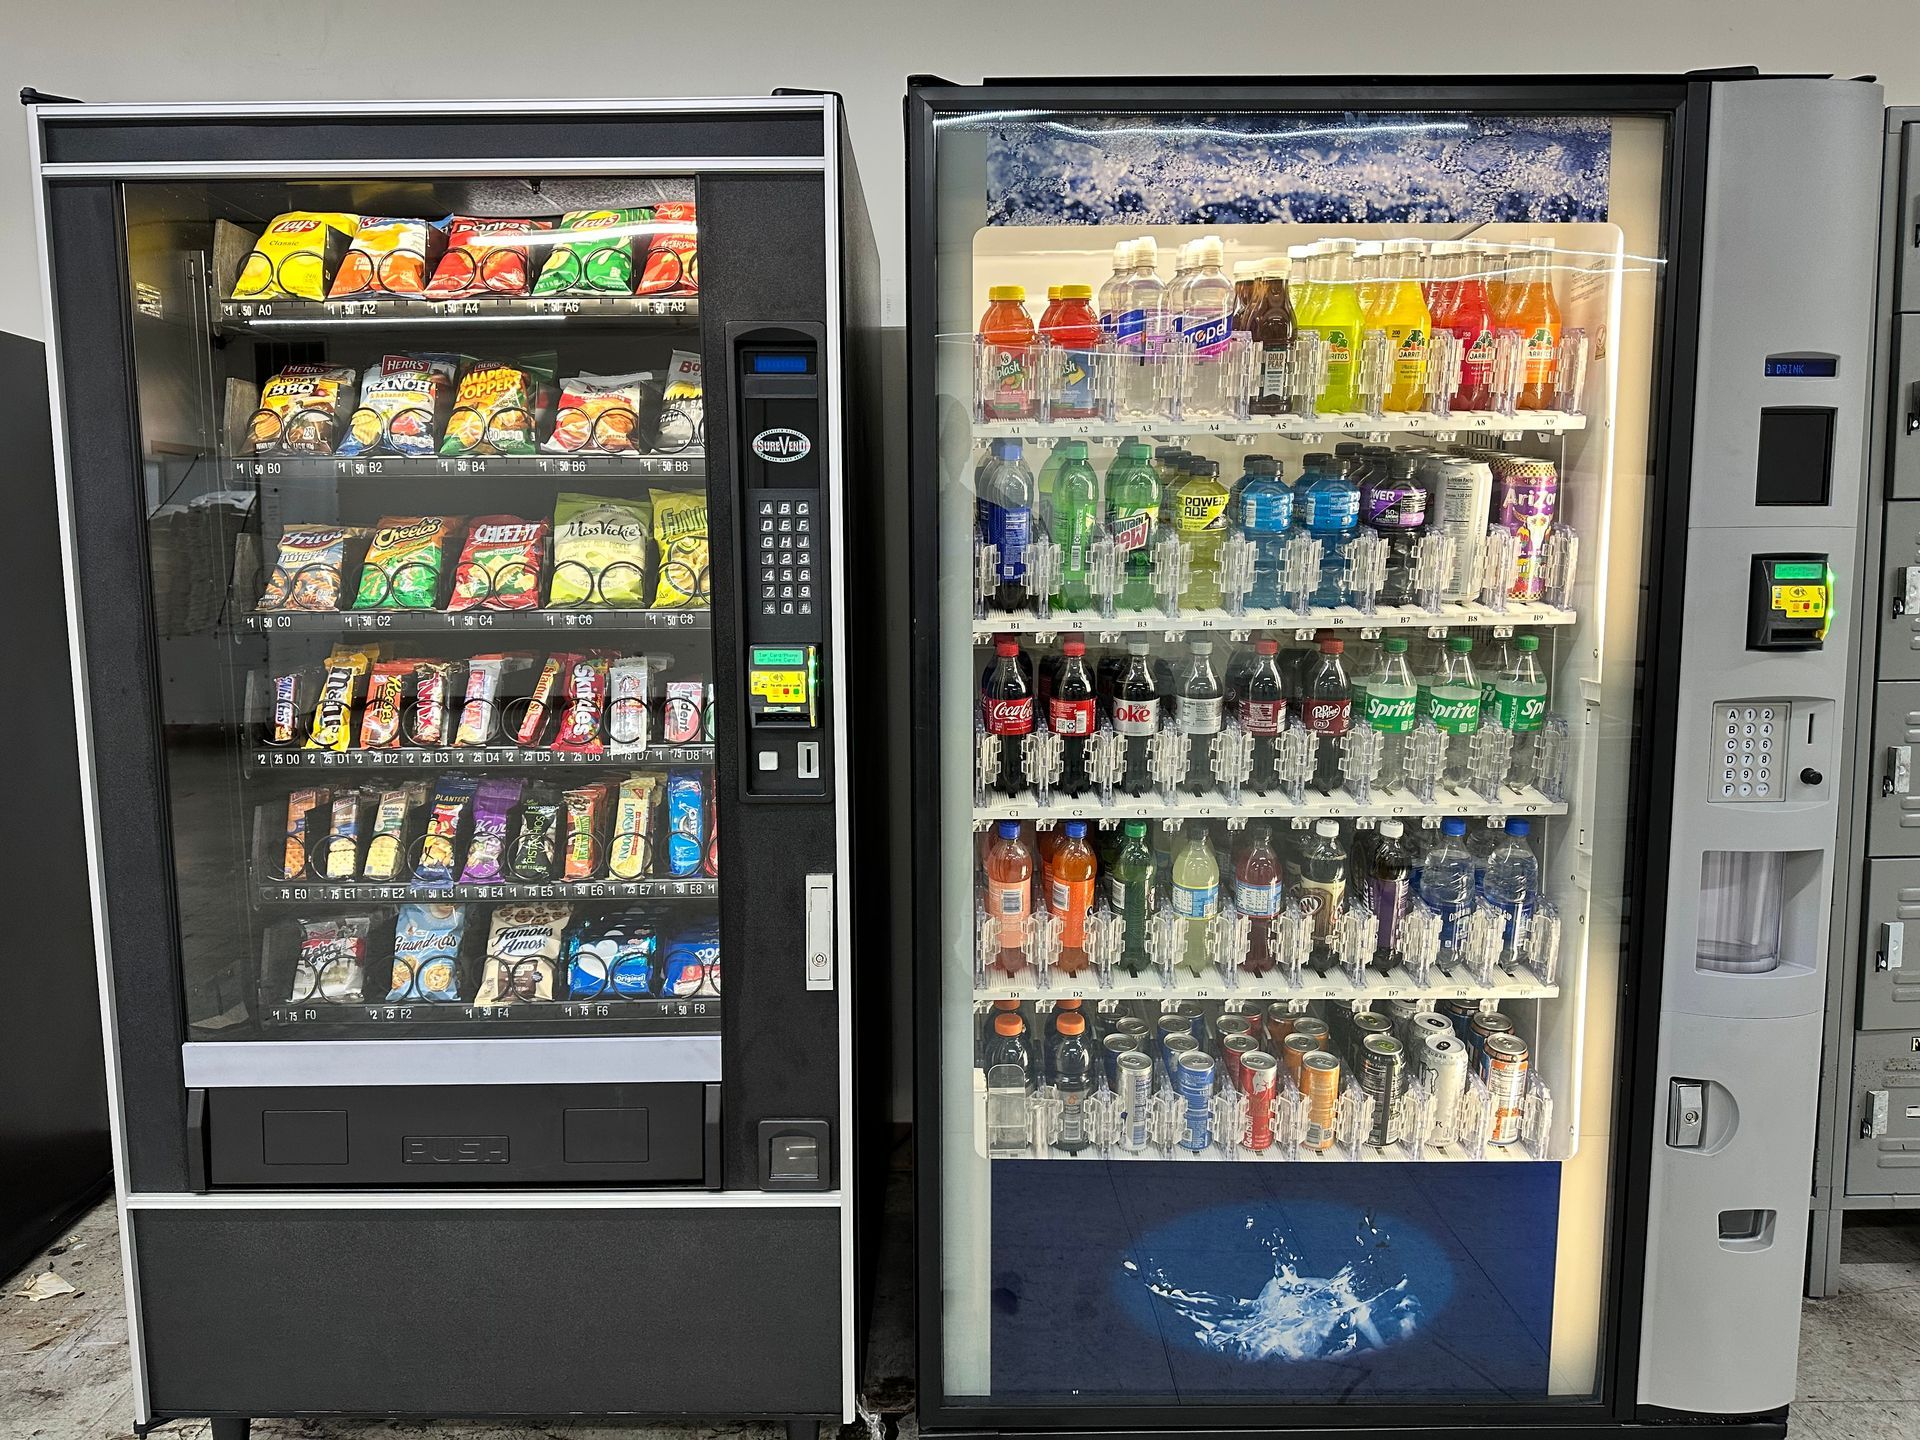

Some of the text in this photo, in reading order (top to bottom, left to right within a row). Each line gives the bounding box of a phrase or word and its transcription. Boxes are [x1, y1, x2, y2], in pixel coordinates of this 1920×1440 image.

[258, 301, 272, 315] A0
[362, 301, 376, 315] A2
[464, 301, 478, 314] A4
[565, 300, 579, 313] A6
[671, 299, 685, 313] A8
[1268, 353, 1284, 361] GOLD
[388, 359, 424, 371] HERR'S
[1776, 364, 1804, 374] DRINK
[270, 384, 315, 396] BBQ
[267, 463, 281, 474] B0
[369, 462, 383, 473] B2
[472, 461, 485, 472] B4
[572, 460, 586, 472] B6
[675, 460, 689, 471] B8
[763, 504, 808, 514] A B C
[1184, 506, 1209, 517] ADE
[564, 518, 643, 542] Miss Vickie's
[763, 520, 808, 531] D E F
[374, 517, 443, 550] Cheetos
[763, 537, 808, 548] G H J
[277, 616, 291, 627] C0
[377, 616, 391, 627] C2
[479, 614, 493, 625] C4
[578, 613, 592, 625] C6
[680, 613, 694, 624] C8
[1368, 698, 1416, 719] Sprite
[1428, 698, 1477, 719] Sprite
[286, 754, 300, 765] D0
[337, 754, 350, 765] D1
[384, 754, 399, 764] D2
[435, 753, 449, 763] D3
[486, 753, 500, 763] D4
[537, 752, 551, 762] D5
[587, 752, 601, 762] D6
[637, 751, 649, 761] D7
[686, 750, 700, 761] D8
[435, 794, 470, 803] PLANTERS
[294, 889, 307, 899] E0
[344, 888, 356, 899] E1
[392, 888, 405, 899] E2
[442, 888, 454, 898] E3
[491, 887, 504, 897] E4
[541, 887, 553, 897] E5
[591, 886, 604, 896] E6
[640, 886, 651, 896] E7
[690, 885, 703, 895] E8
[492, 926, 554, 945] Famous
[401, 1009, 412, 1019] F2
[498, 1008, 509, 1018] F4
[597, 1007, 609, 1016] F6
[694, 1004, 706, 1014] F8
[305, 1010, 317, 1020] F0
[406, 1142, 507, 1163] PUSH
